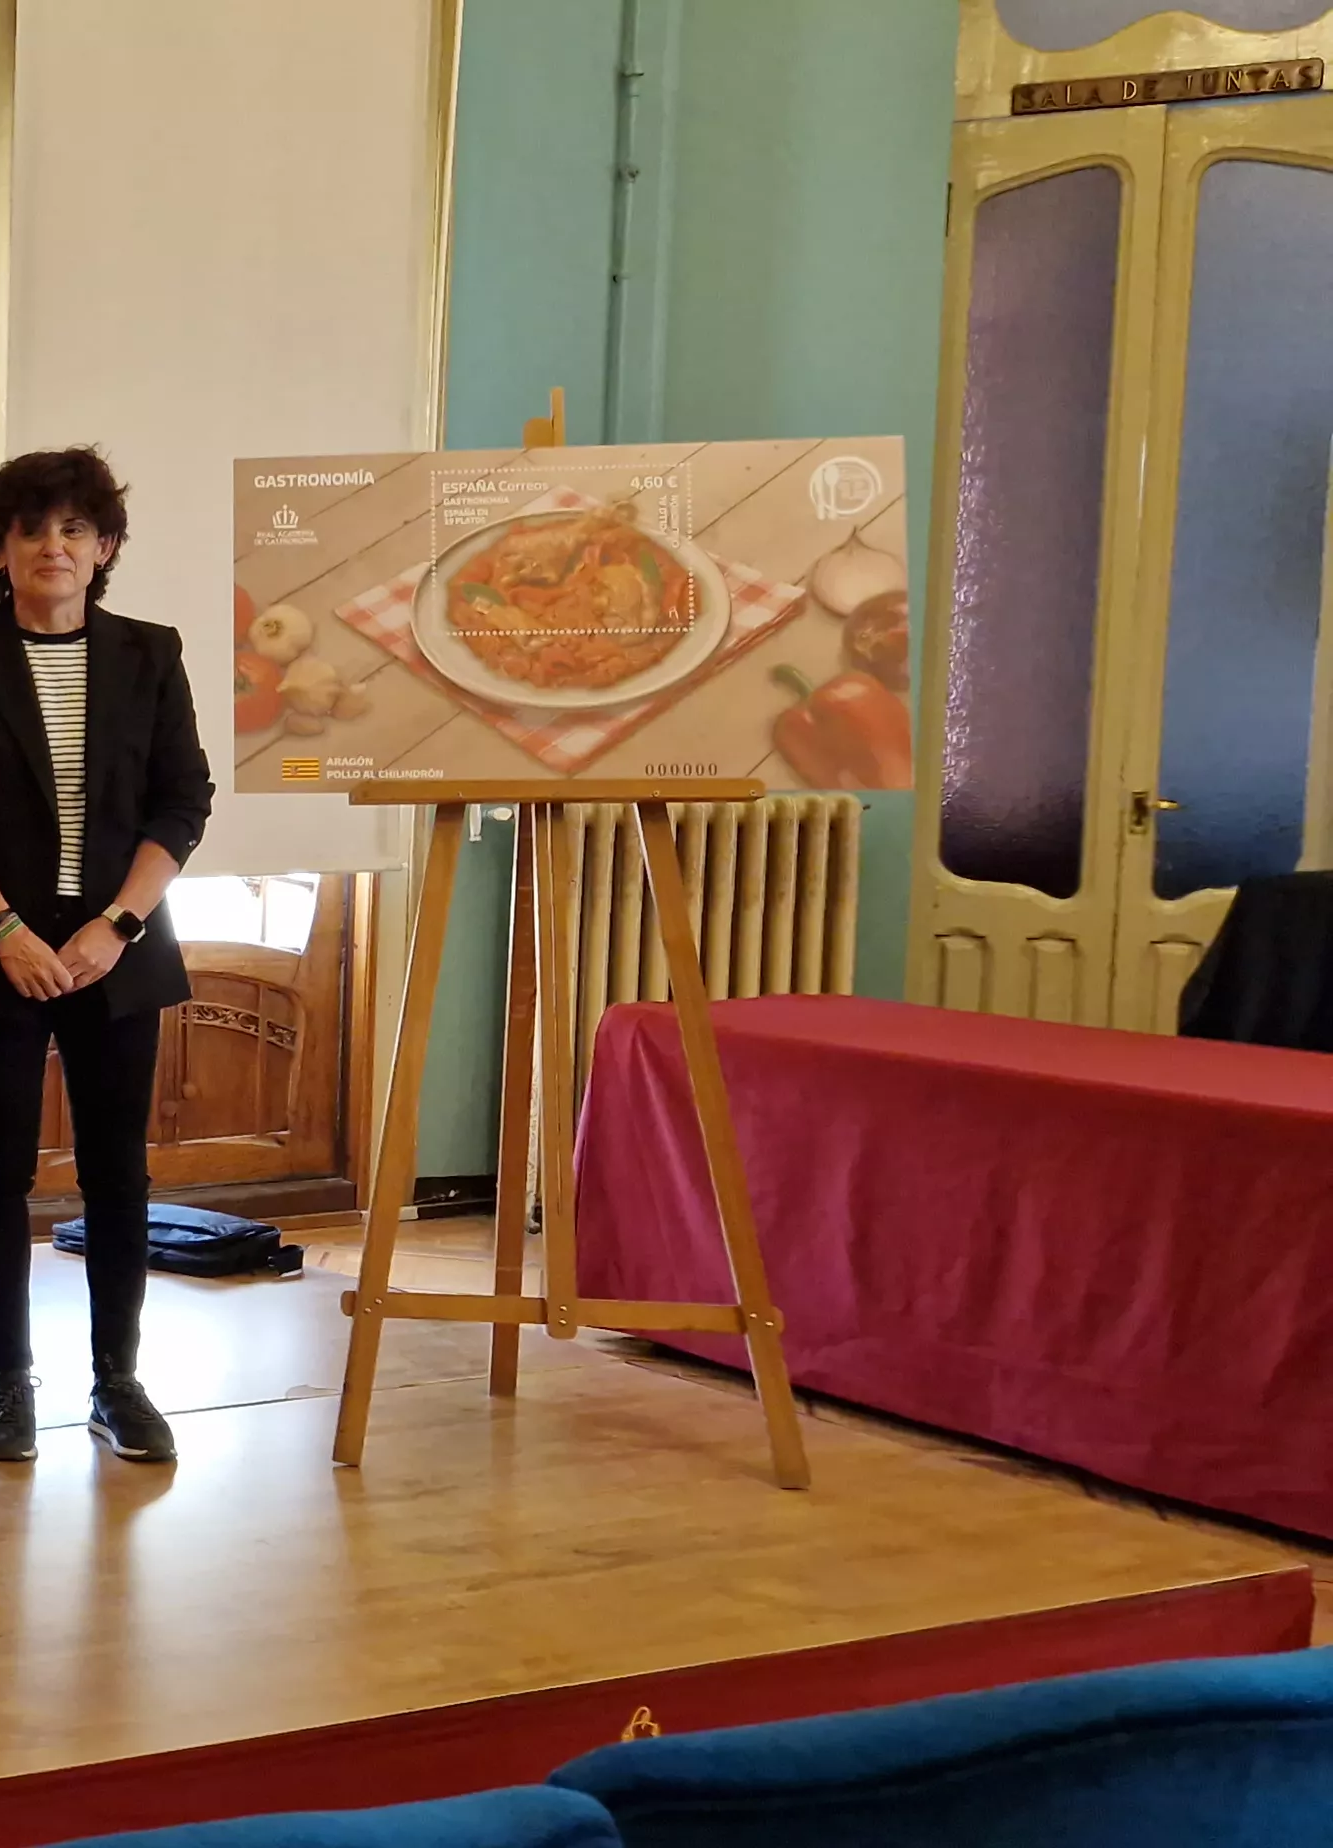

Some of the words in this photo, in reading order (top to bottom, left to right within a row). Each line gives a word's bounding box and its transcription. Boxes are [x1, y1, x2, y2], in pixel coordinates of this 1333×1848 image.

[1020, 84, 1103, 110] SALA
[1121, 80, 1158, 101] DE
[254, 468, 375, 488] GASTRONOMÍA
[630, 476, 663, 491] 4,60
[442, 479, 496, 494] ESPAÑA
[498, 480, 549, 492] Correos
[326, 755, 374, 767] ARAGÓN
[326, 769, 361, 780] POLLO
[363, 769, 375, 779] AL
[378, 768, 444, 779] CHILINDRÓN
[645, 763, 718, 776] 000000
